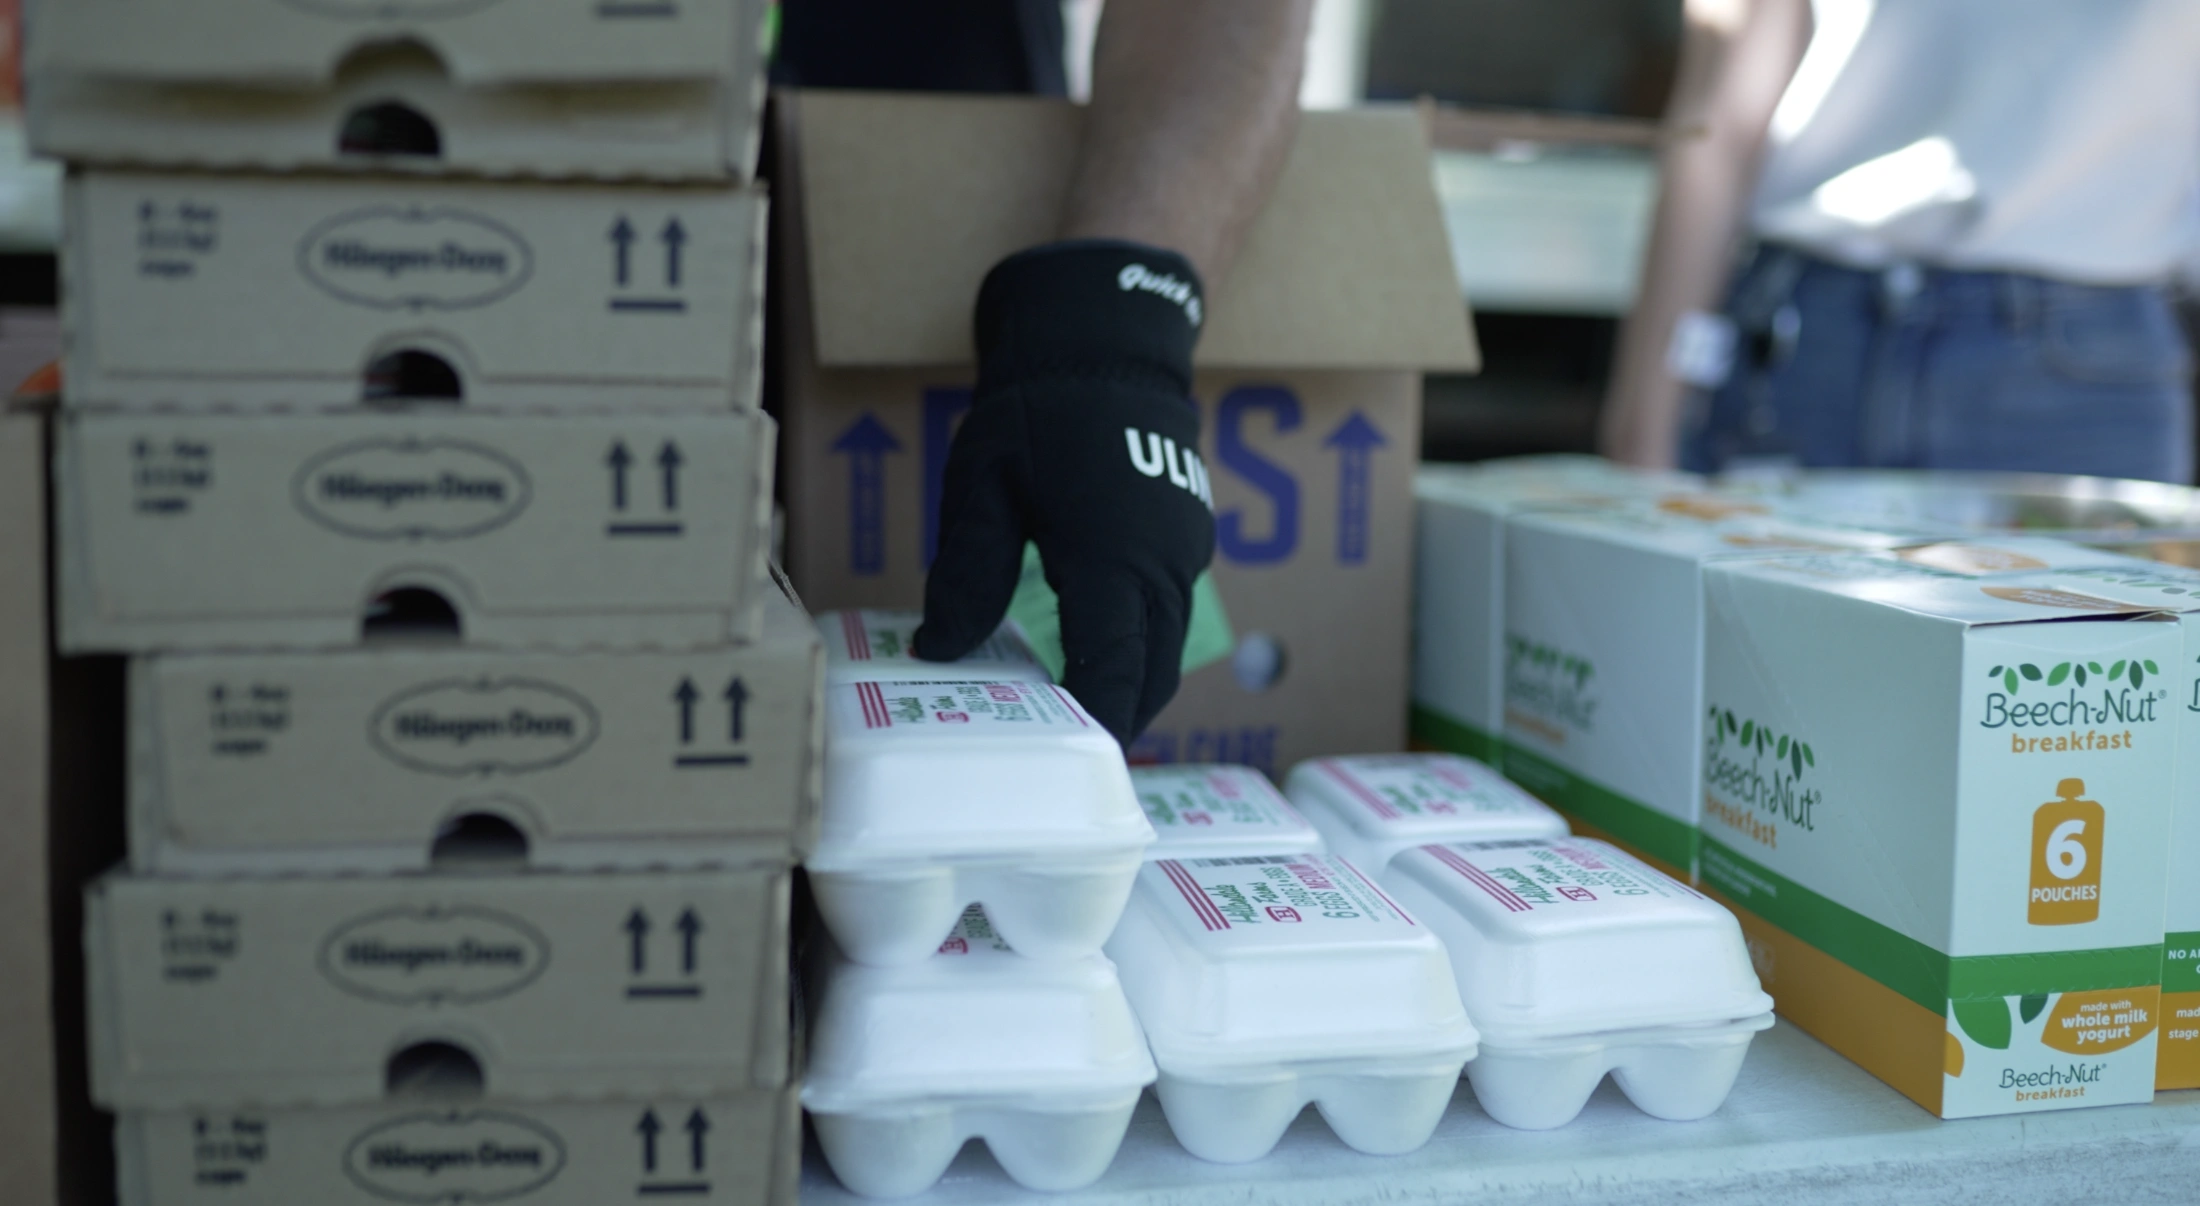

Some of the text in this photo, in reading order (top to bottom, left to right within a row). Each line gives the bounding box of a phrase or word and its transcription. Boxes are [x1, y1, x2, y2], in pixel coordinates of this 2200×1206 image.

[1117, 262, 1192, 306] Quick
[1980, 687, 2158, 729] Beech-Nut
[2011, 730, 2133, 754] breakfast
[2045, 819, 2088, 880] 6
[1285, 864, 1335, 889] MEDIUM
[1279, 886, 1319, 907] GRADE
[1312, 891, 1354, 910] EGGS
[1612, 888, 1651, 897] 6
[2031, 884, 2098, 903] POUCHES
[2168, 949, 2187, 960] NO
[2080, 1000, 2132, 1013] made with
[2062, 1009, 2148, 1029] whole milk
[2077, 1025, 2131, 1045] yogurt
[2168, 1028, 2199, 1040] stage
[1999, 1063, 2101, 1088] Beech-Nut
[2016, 1086, 2085, 1102] breakfast
